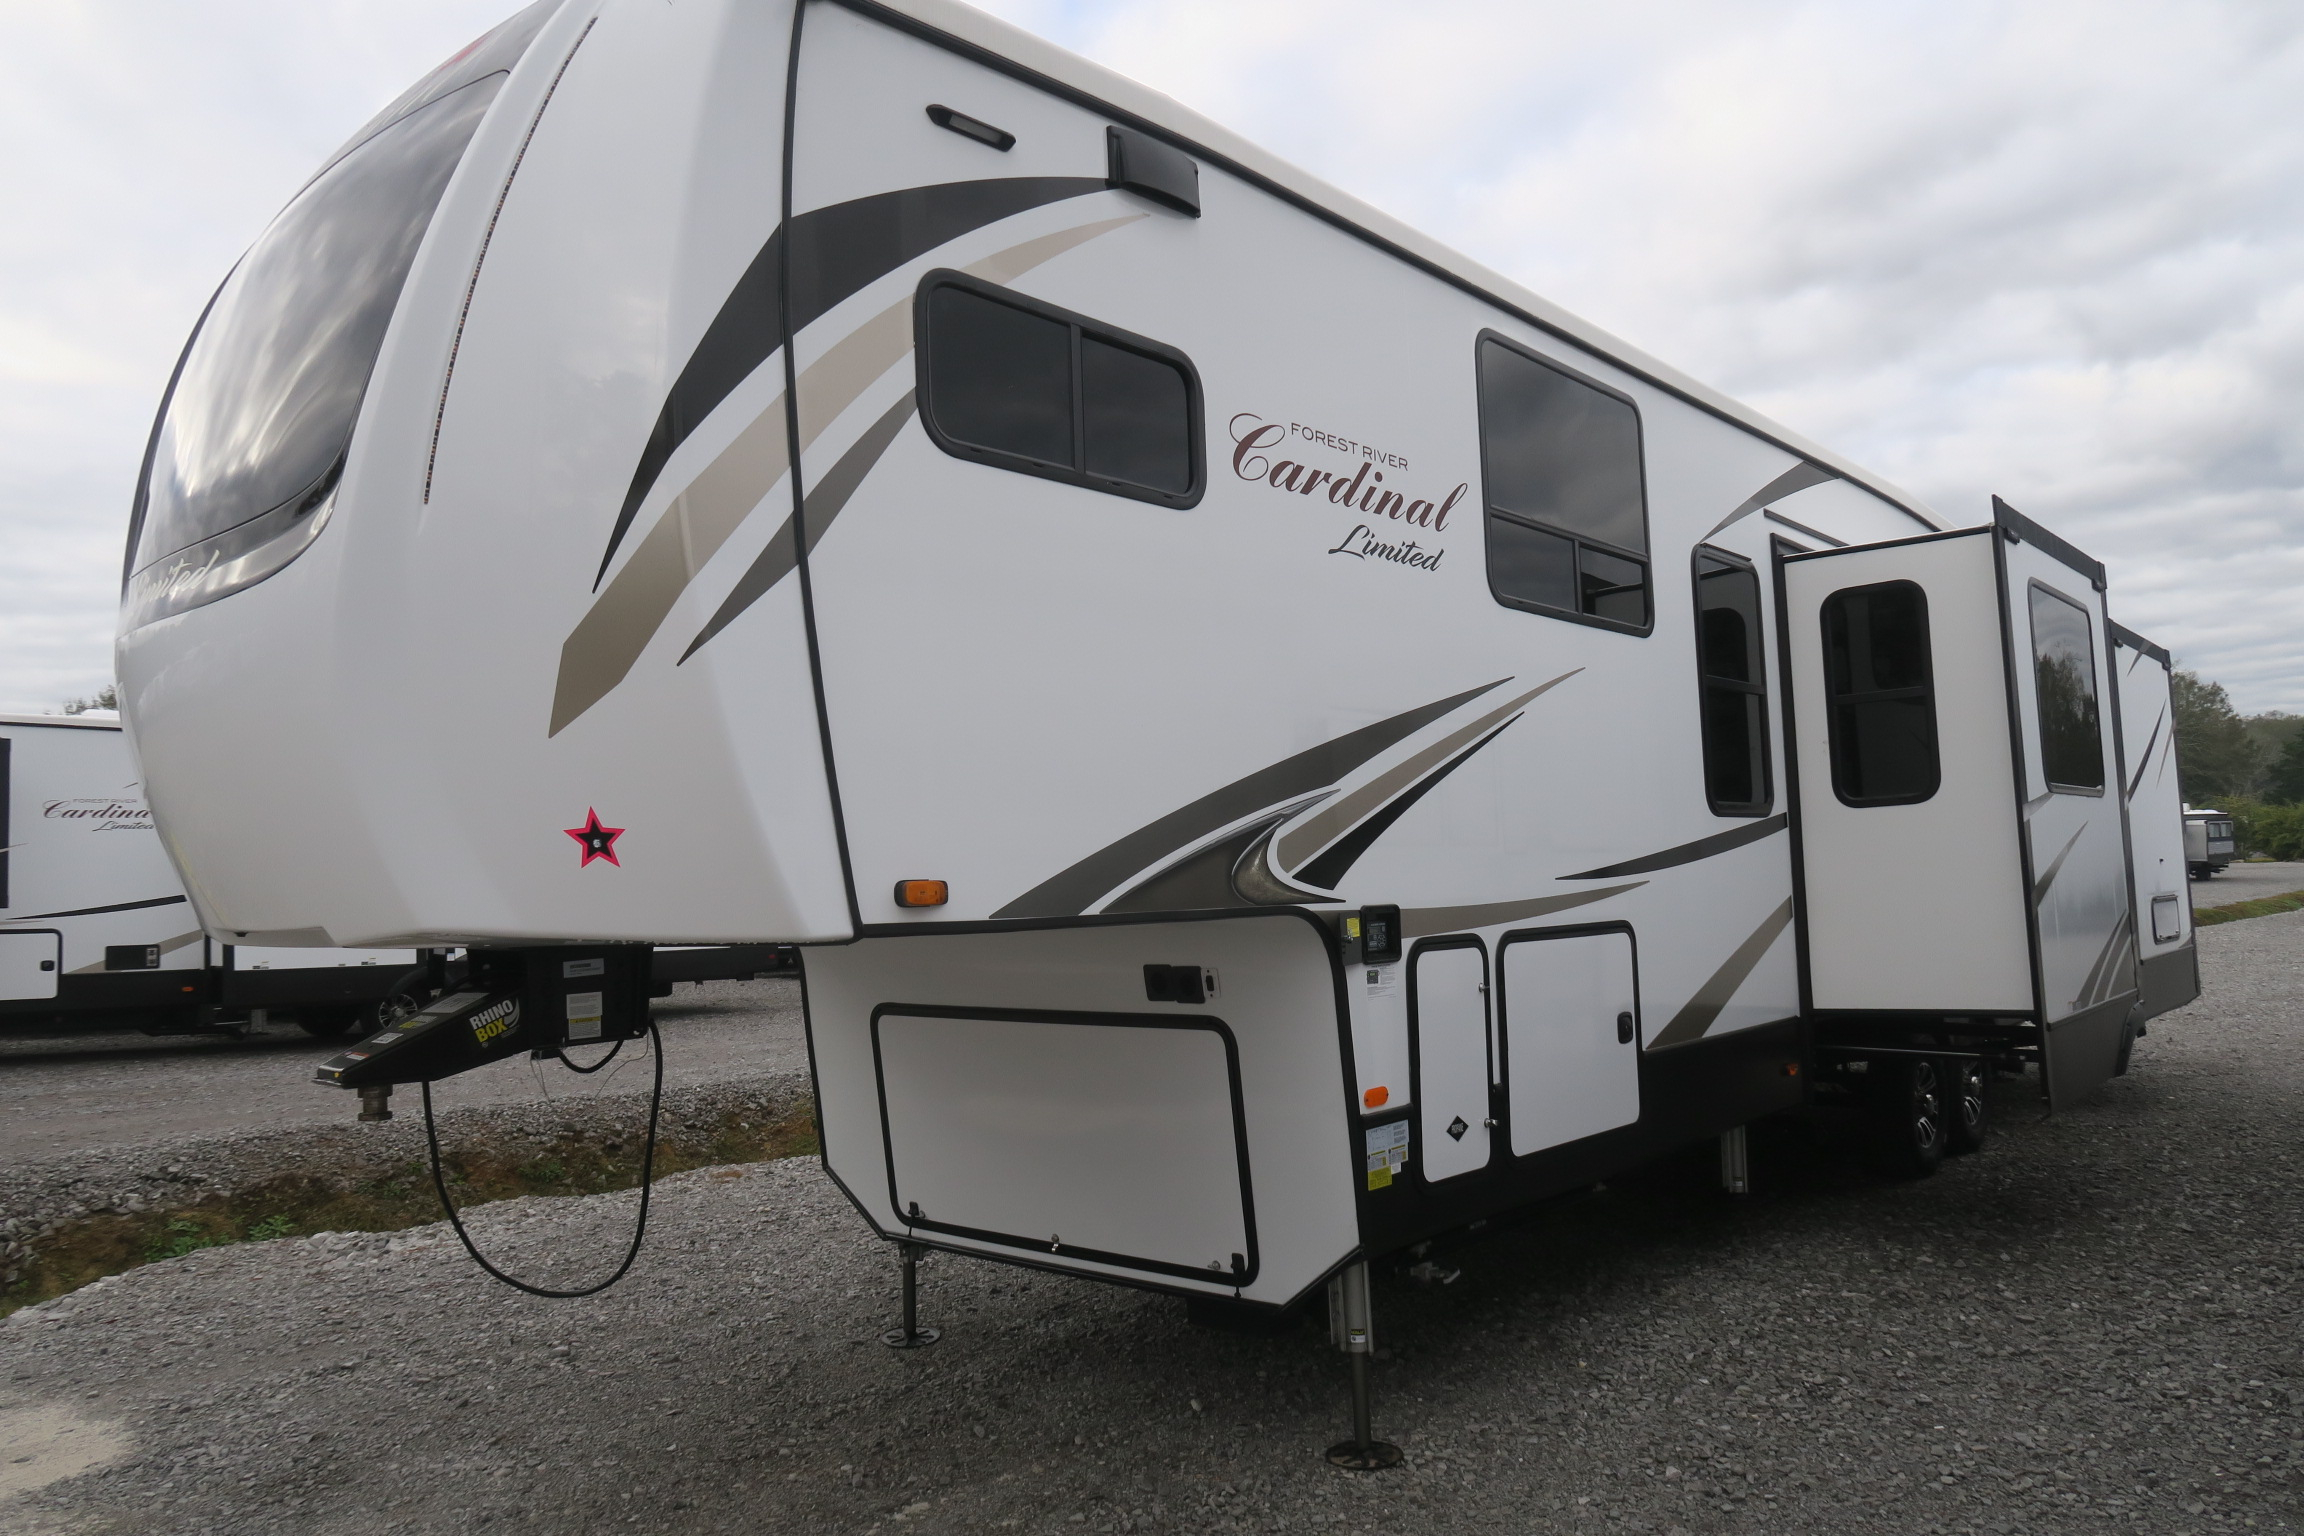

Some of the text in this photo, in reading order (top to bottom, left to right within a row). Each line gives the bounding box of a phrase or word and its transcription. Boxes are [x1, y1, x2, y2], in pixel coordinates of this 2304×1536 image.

[1291, 422, 1408, 472] FOREST RIVER
[1229, 412, 1468, 532] Cardinal
[1328, 524, 1444, 572] Limited
[42, 799, 152, 819] Cardina
[469, 1000, 514, 1030] RHINO
[475, 1017, 508, 1043] BOX
